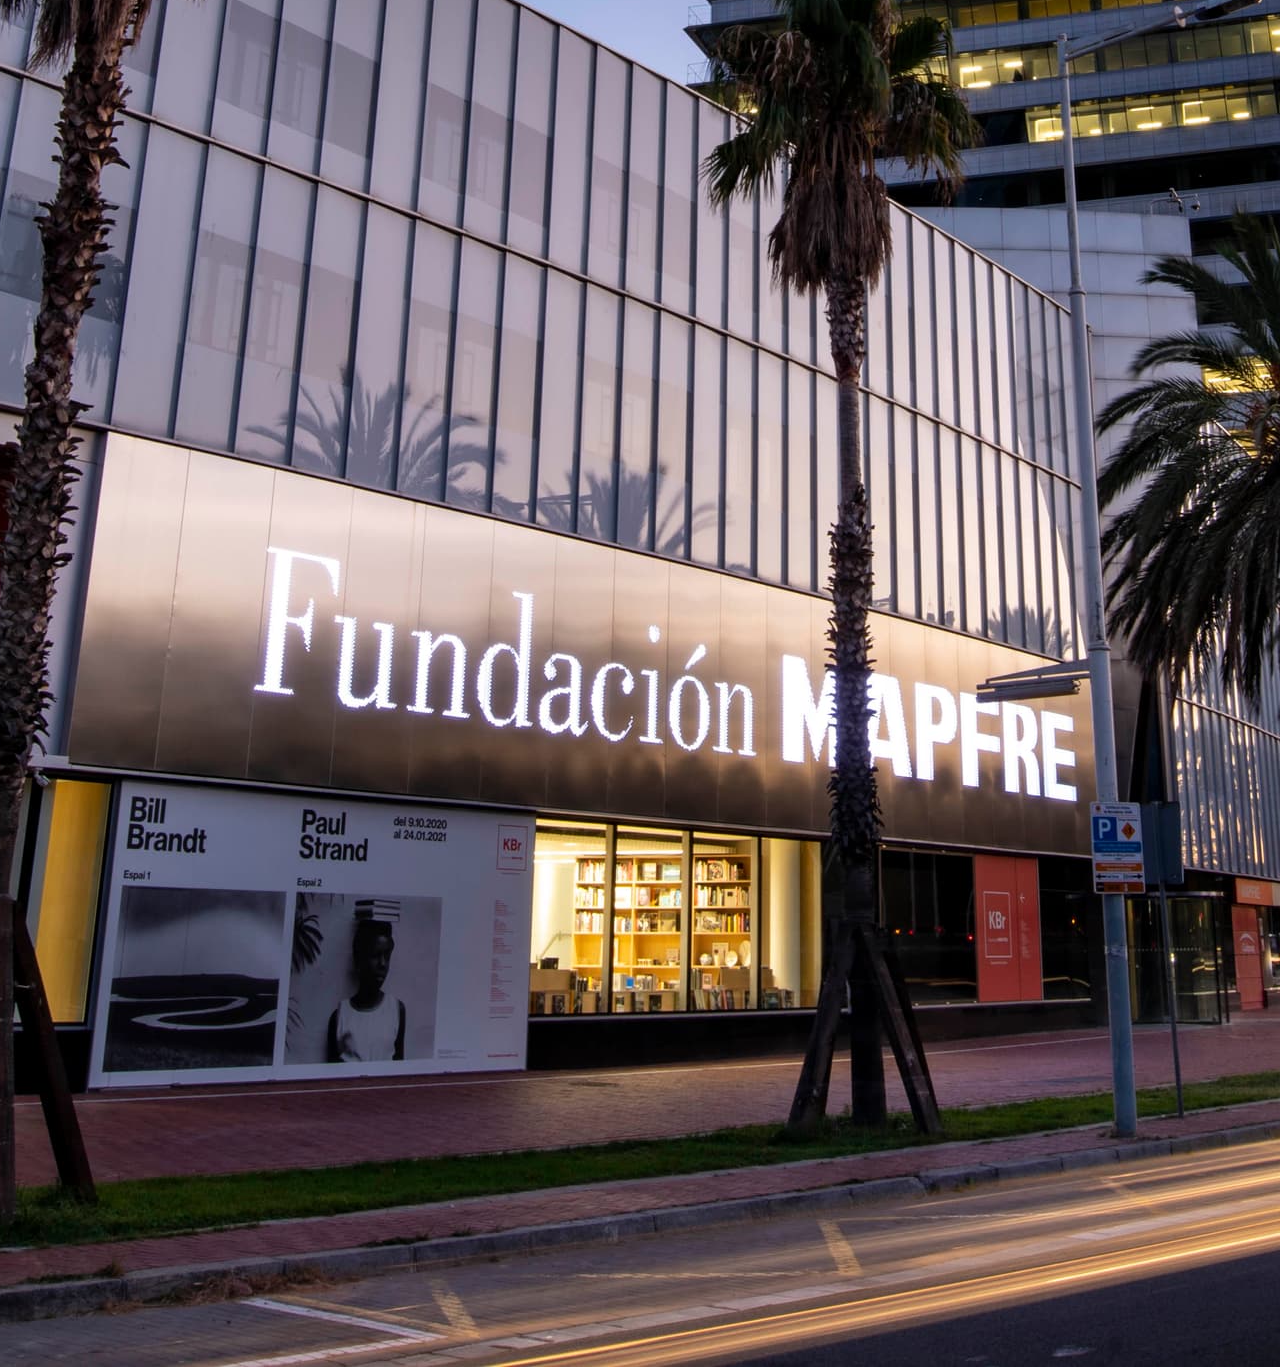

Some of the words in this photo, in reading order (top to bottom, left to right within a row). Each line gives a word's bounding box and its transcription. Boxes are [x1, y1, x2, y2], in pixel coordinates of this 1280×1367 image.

[254, 545, 757, 757] Fundación
[782, 654, 1078, 802] MAPFRE
[129, 796, 167, 824] Bill
[302, 809, 347, 836] Paul
[393, 817, 406, 827] del
[408, 817, 447, 829] 9.10.2020
[1098, 818, 1111, 839] P
[127, 823, 207, 853] Brandt
[393, 830, 401, 839] al
[403, 830, 447, 842] 24.01.2021
[503, 838, 522, 851] KBr
[299, 835, 368, 862] Strand
[123, 869, 146, 881] Espai
[297, 877, 317, 888] Espai
[988, 910, 1007, 929] KBr
